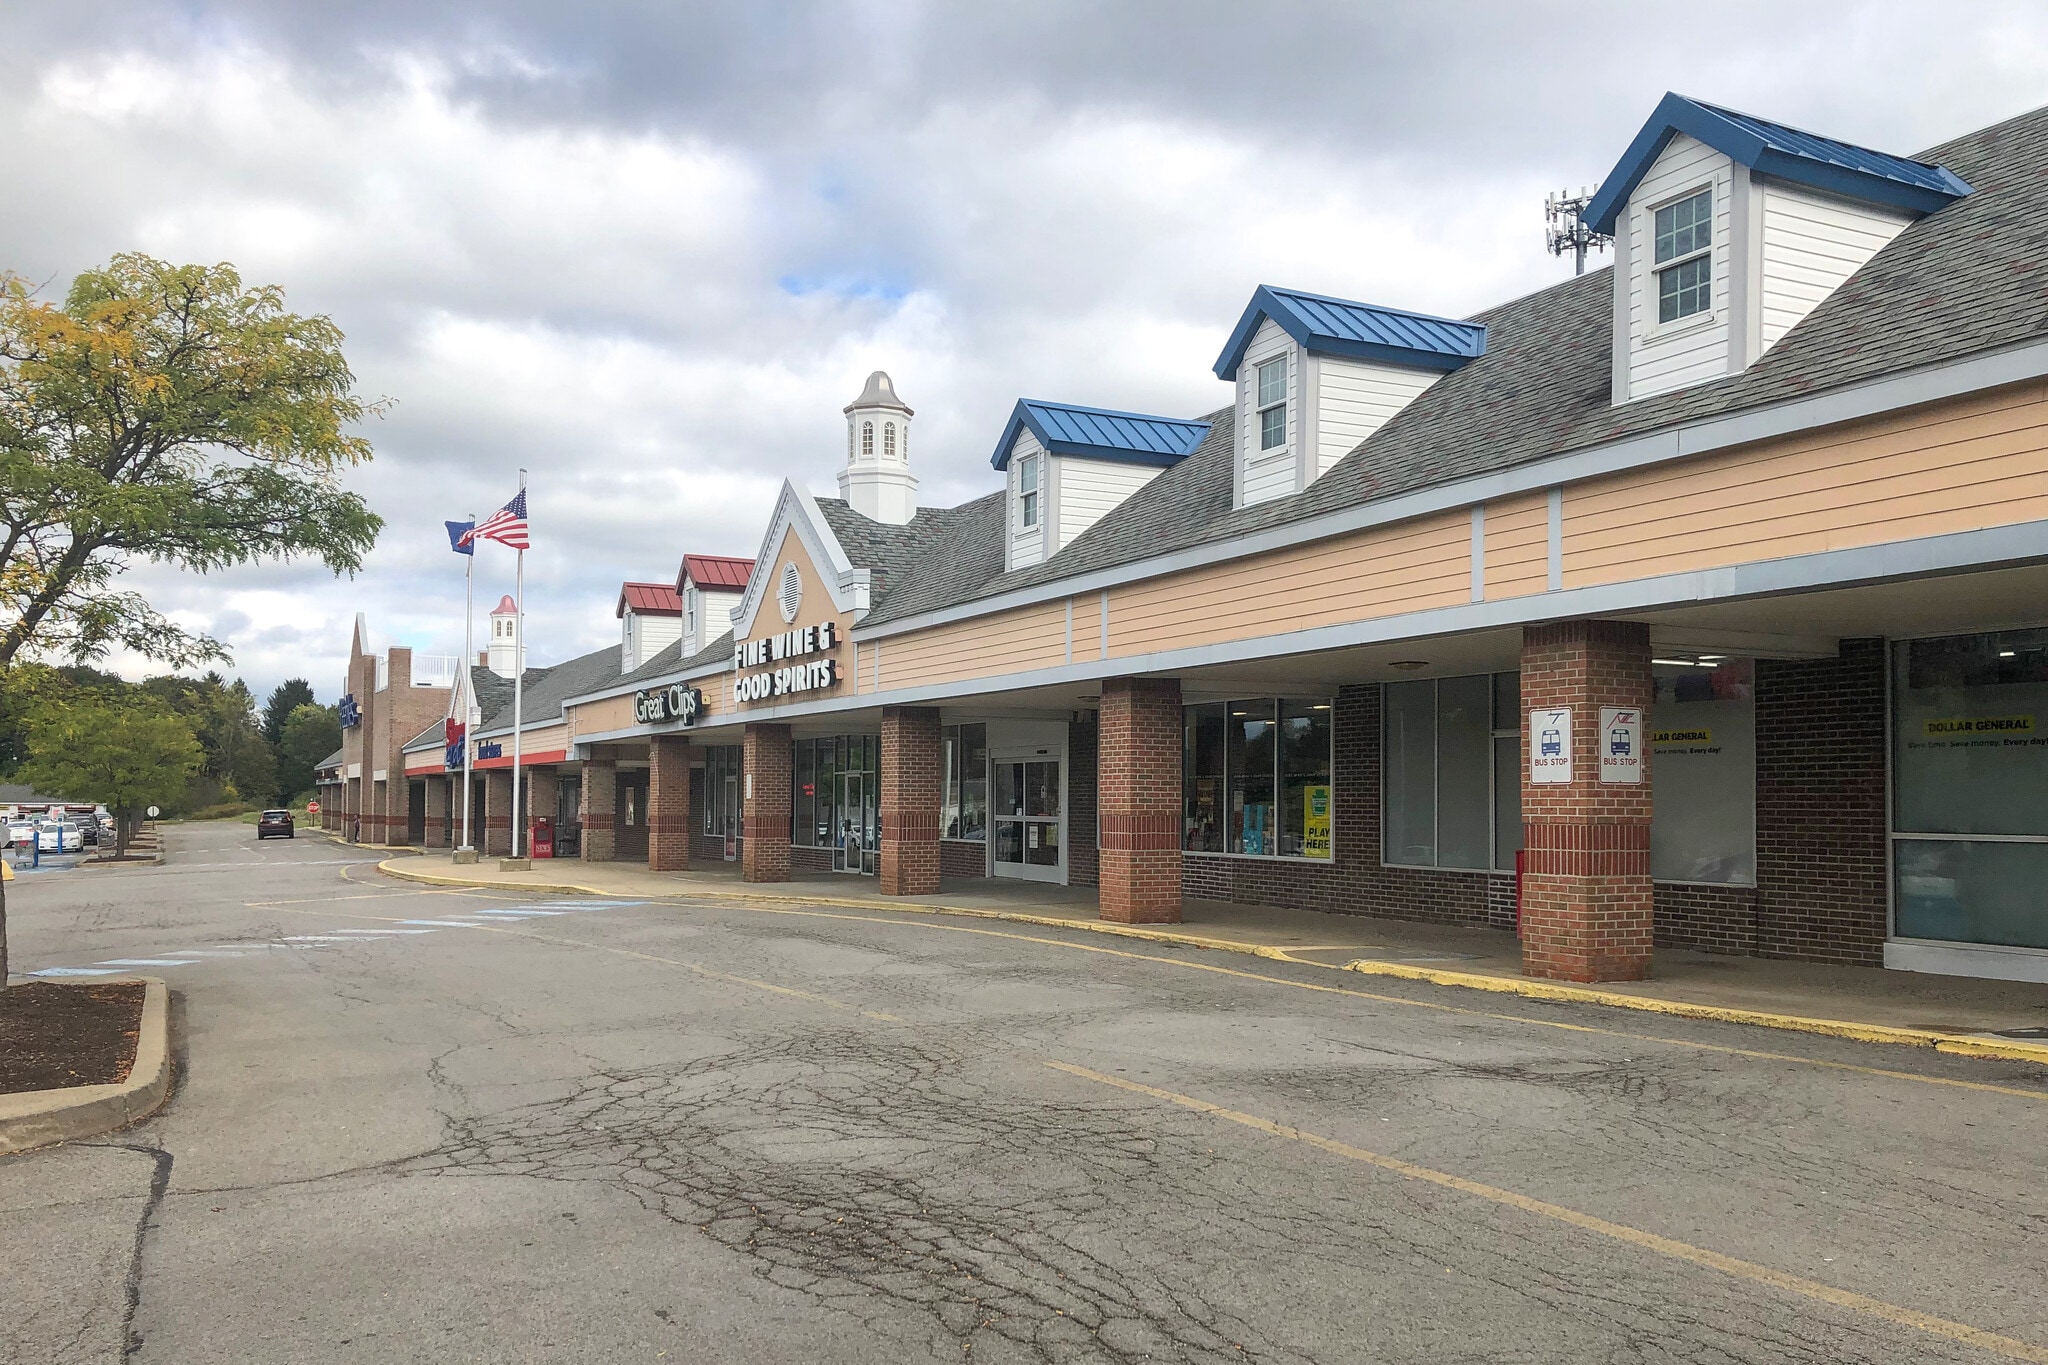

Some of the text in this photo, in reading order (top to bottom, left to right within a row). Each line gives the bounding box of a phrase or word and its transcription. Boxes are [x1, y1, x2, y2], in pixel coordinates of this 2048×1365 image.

[734, 621, 835, 669] FINE WINE &
[733, 659, 835, 703] GOOD SPIRITS
[635, 684, 700, 725] Great Clips
[1928, 719, 2030, 732] DOLLAR GENERAL
[1672, 731, 1708, 740] GENERAL
[2003, 738, 2028, 747] Every
[1690, 747, 1707, 755] Every
[1708, 746, 1722, 754] day!
[1550, 758, 1568, 766] STOP
[1620, 758, 1638, 766] STOP
[1309, 828, 1330, 837] PLAY
